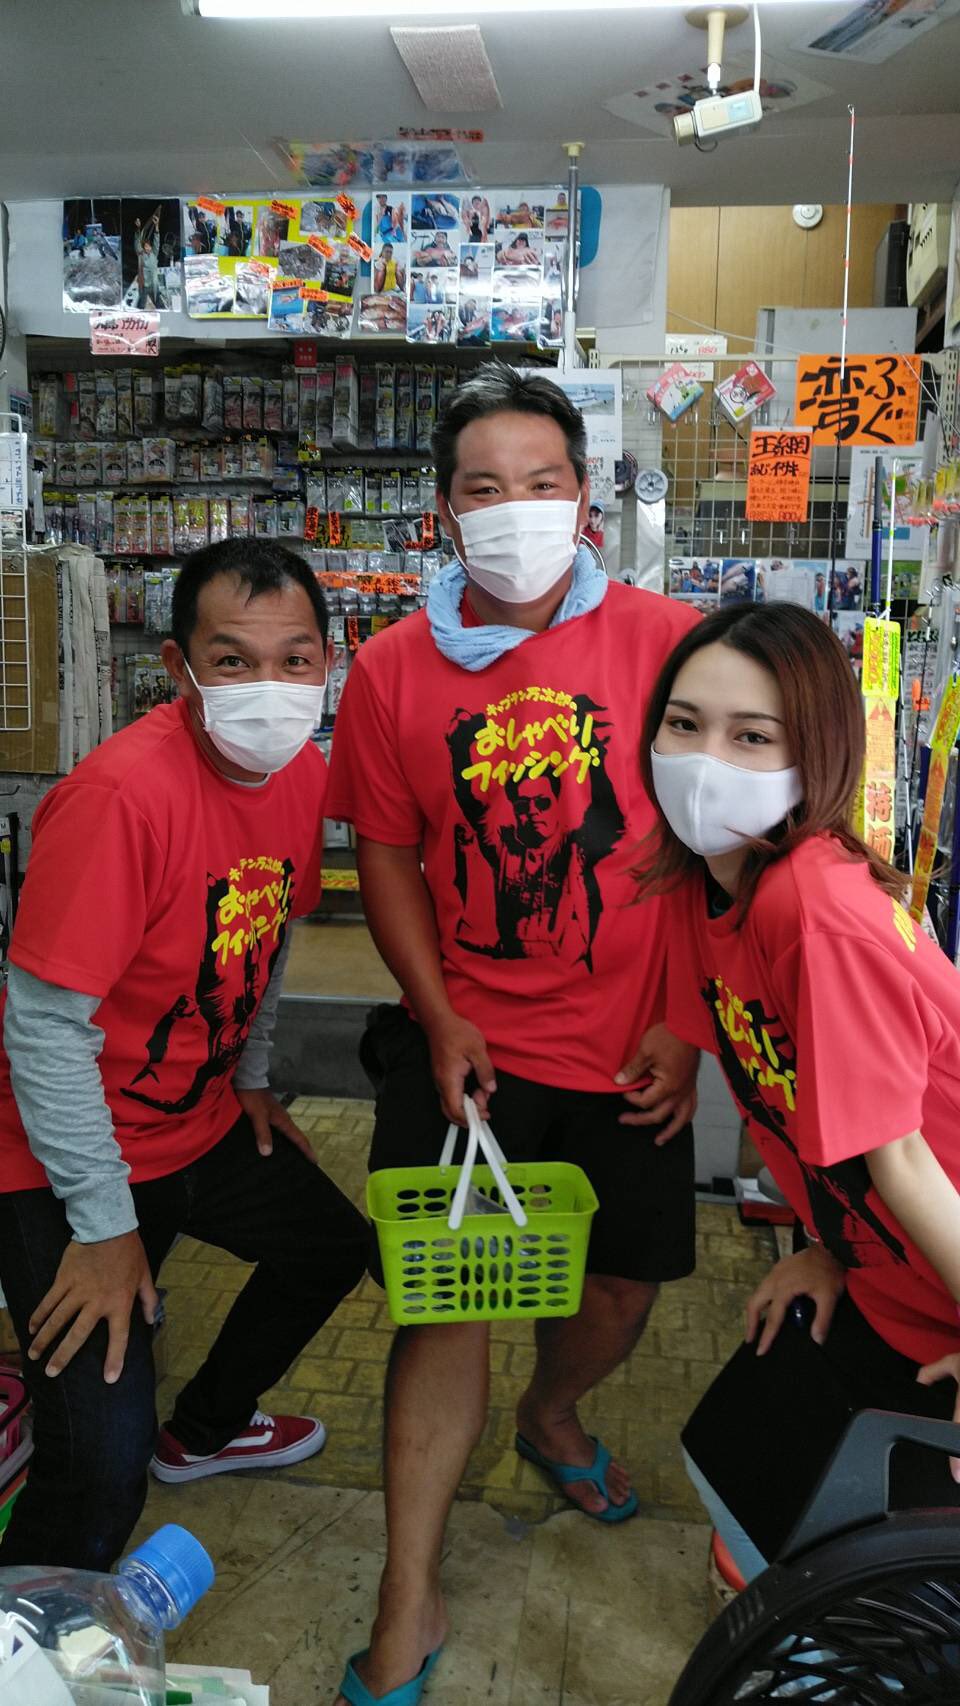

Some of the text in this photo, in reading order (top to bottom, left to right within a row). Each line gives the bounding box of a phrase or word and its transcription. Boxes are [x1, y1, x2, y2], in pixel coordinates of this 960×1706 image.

[475, 713, 594, 755] おしゃべり
[462, 746, 600, 792] フィッシング
